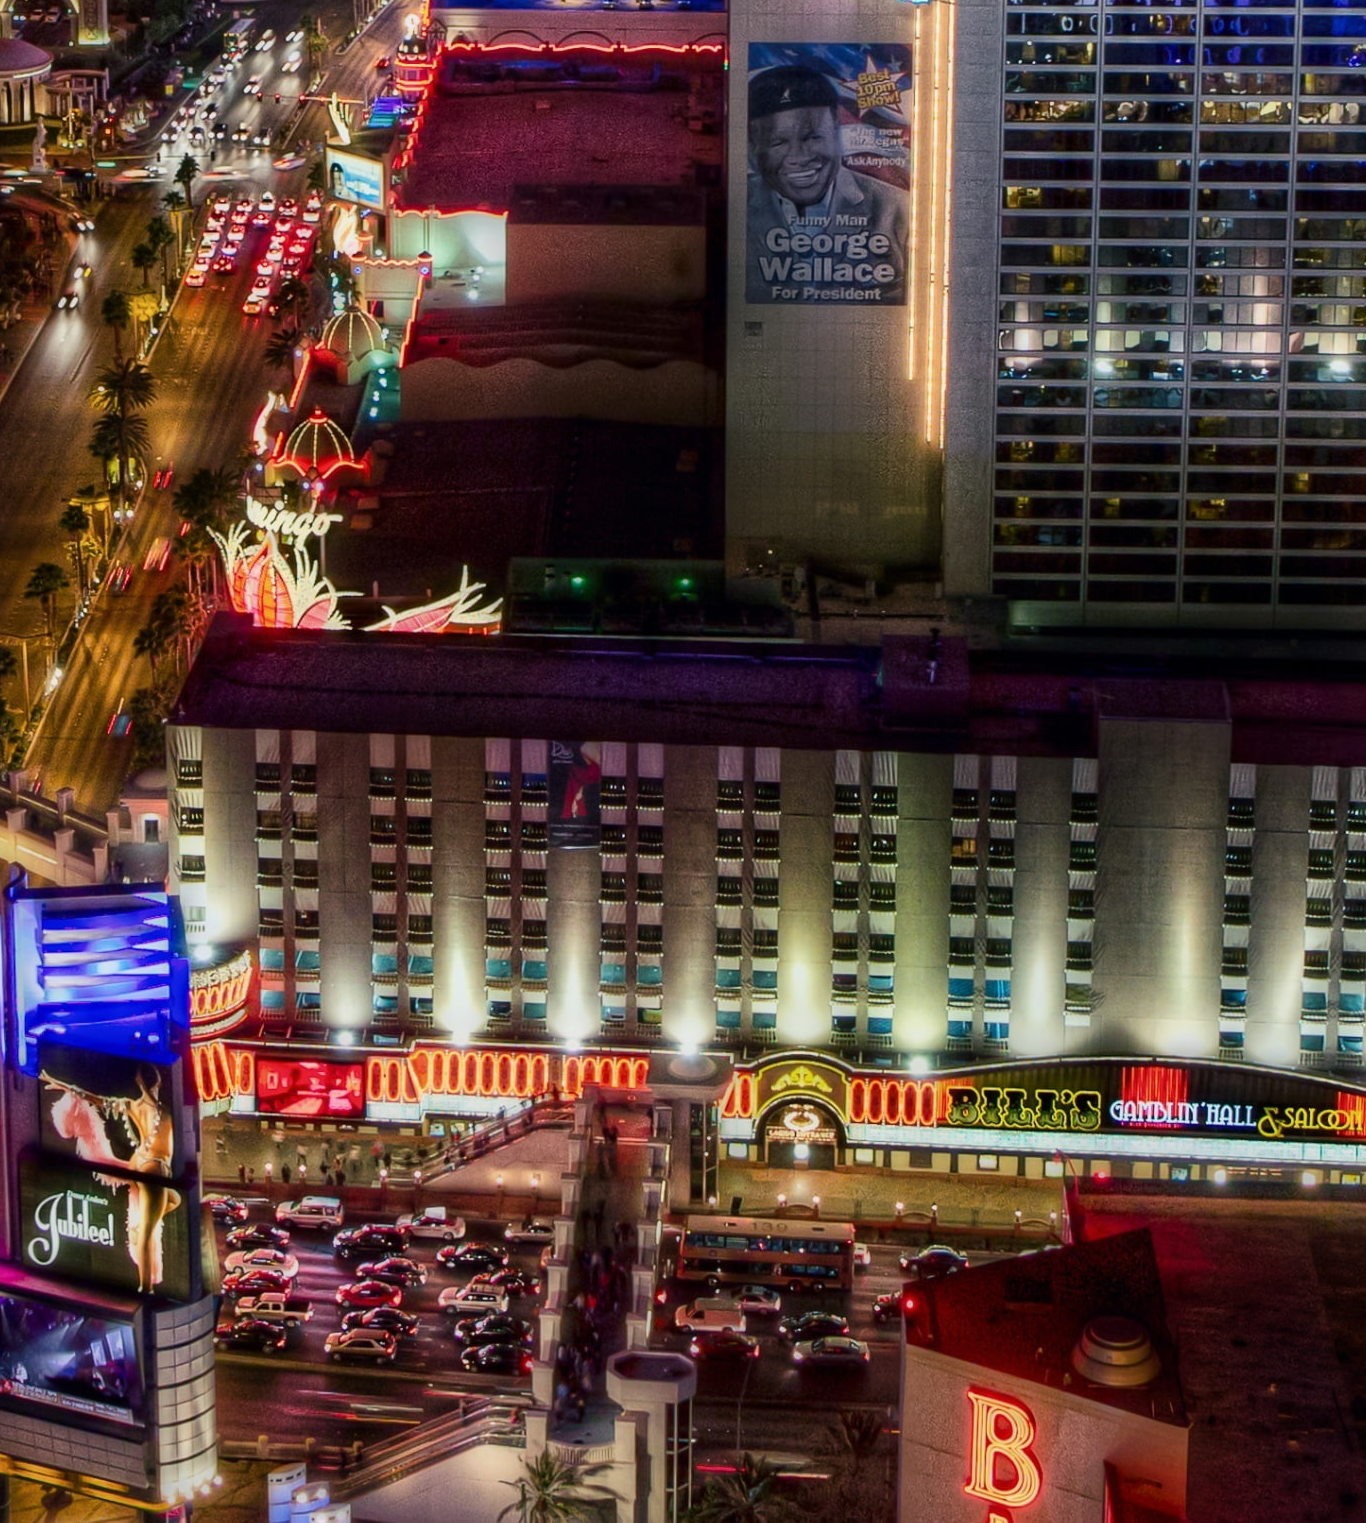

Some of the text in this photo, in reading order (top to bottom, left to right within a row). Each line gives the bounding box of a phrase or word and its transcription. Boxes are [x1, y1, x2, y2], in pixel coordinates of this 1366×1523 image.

[857, 68, 890, 84] Best
[857, 91, 901, 110] Show!
[879, 128, 902, 136] new
[788, 214, 867, 227] Funny Man
[765, 228, 891, 259] George
[758, 257, 896, 283] Wallace
[772, 286, 882, 300] For President
[946, 1085, 1102, 1131] BILL'S
[1109, 1099, 1364, 1138] GAMBLIN' HALL & SALOON
[27, 1191, 115, 1266] Jubilee!
[752, 1221, 788, 1232] 139
[963, 1388, 1042, 1523] B
